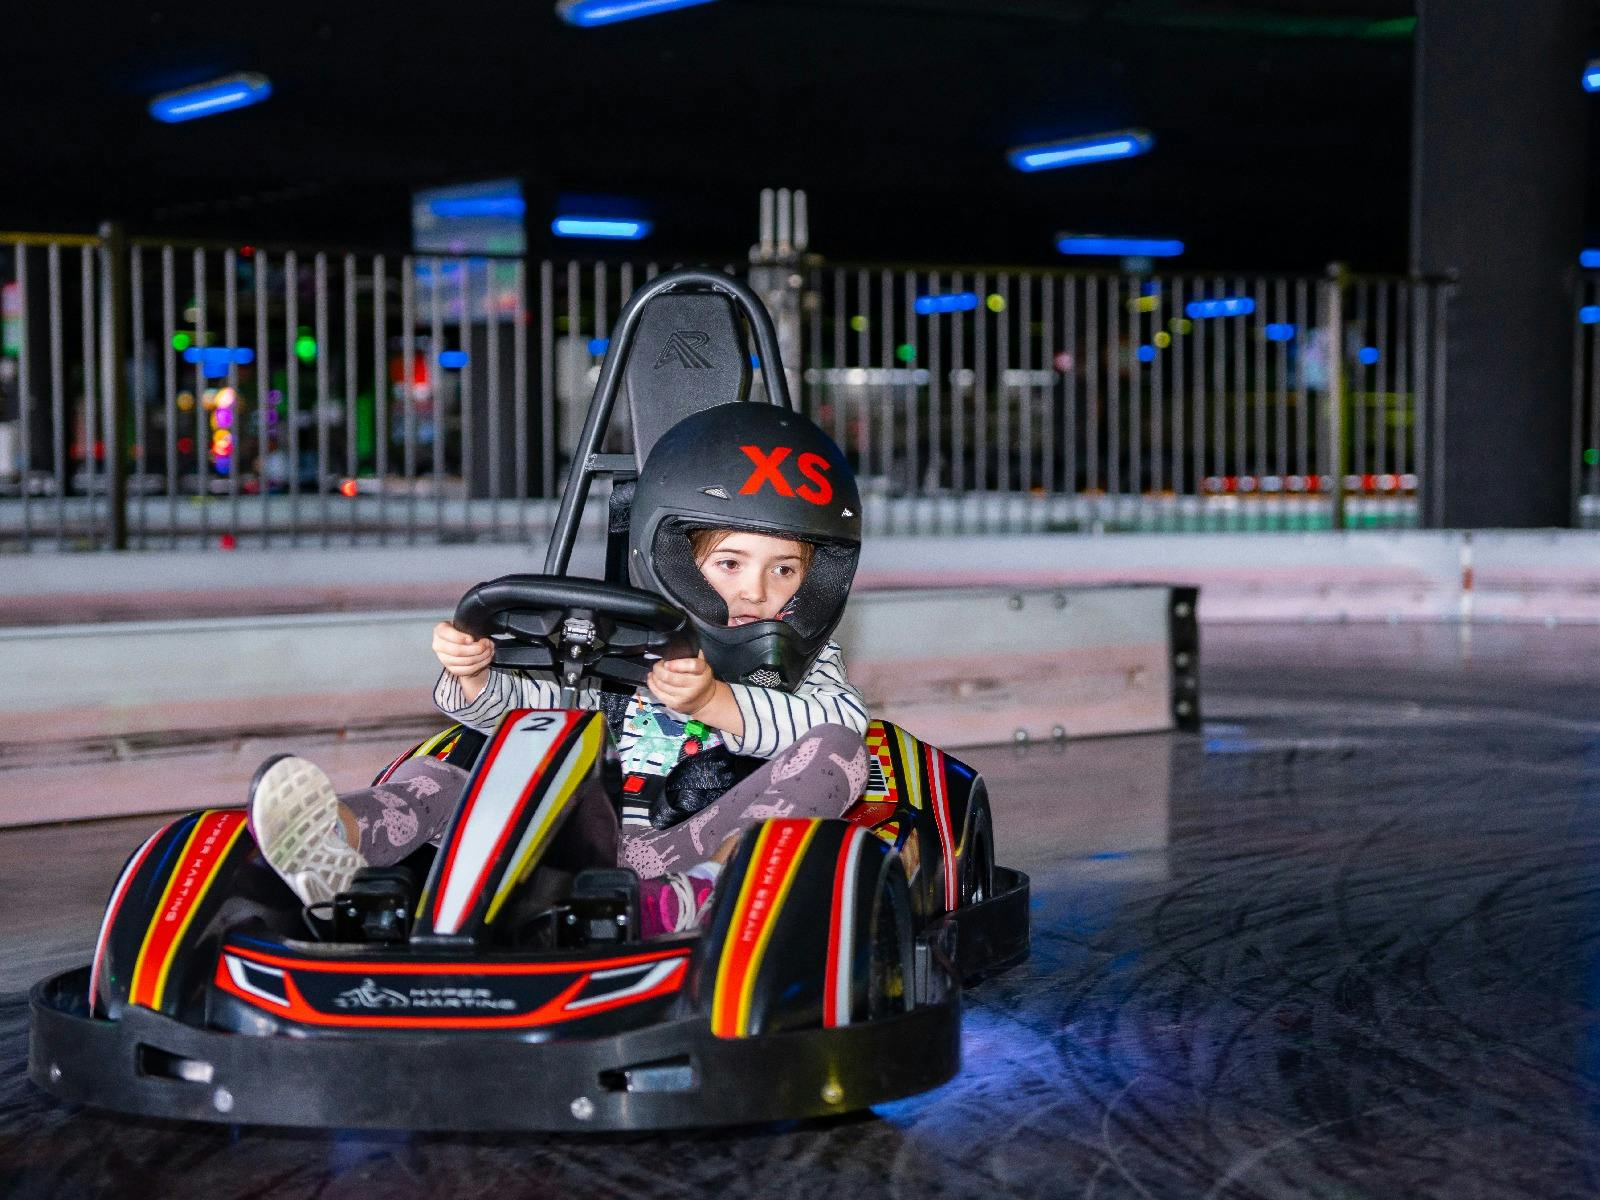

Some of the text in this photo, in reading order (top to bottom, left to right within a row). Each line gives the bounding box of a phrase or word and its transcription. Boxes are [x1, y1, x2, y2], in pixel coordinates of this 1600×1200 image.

[738, 445, 833, 506] XS
[520, 717, 556, 731] 2
[165, 859, 202, 922] KARTING
[409, 988, 492, 999] HYPER
[412, 998, 517, 1010] KARTING
